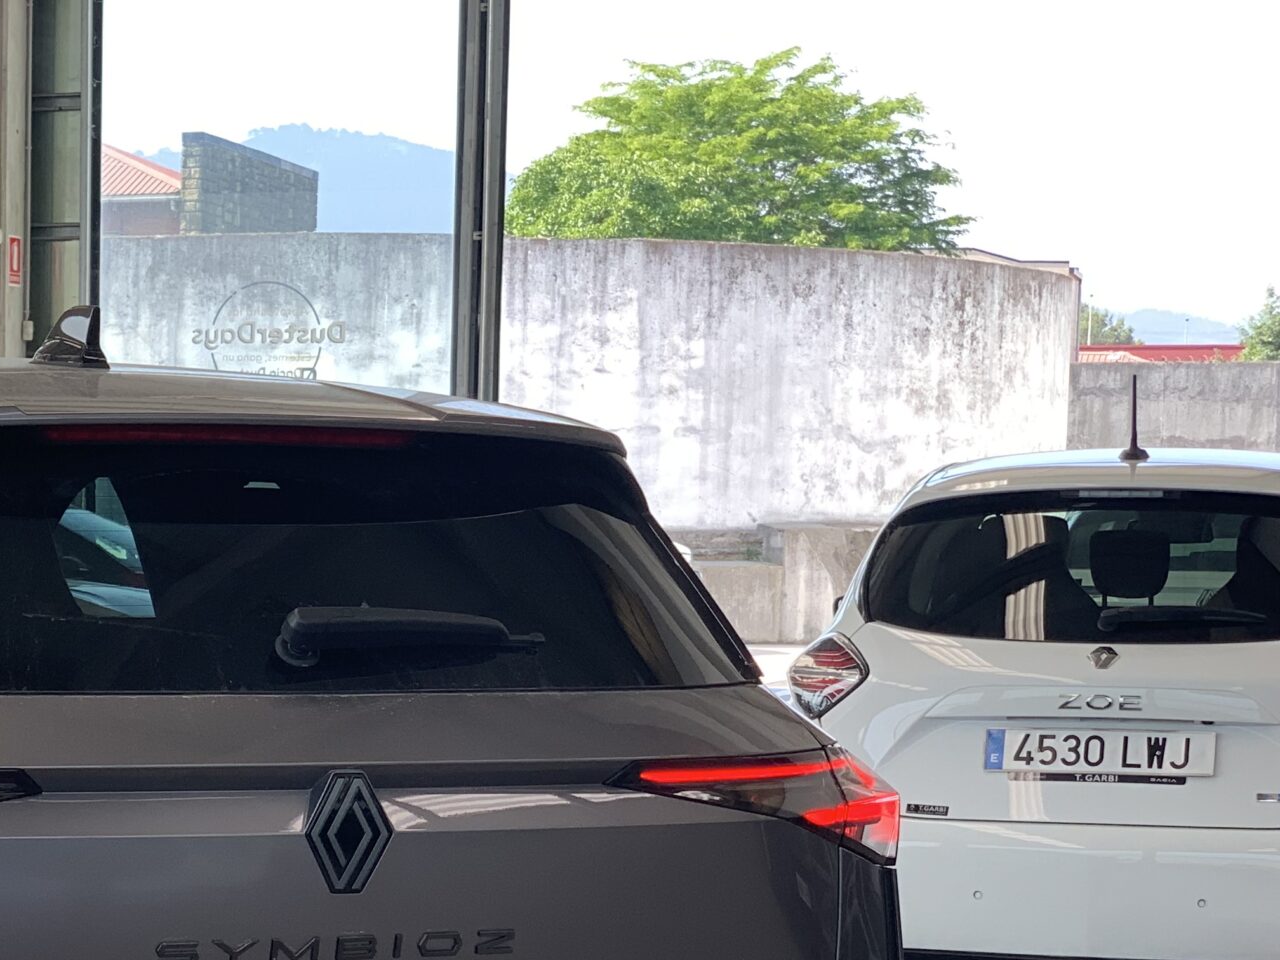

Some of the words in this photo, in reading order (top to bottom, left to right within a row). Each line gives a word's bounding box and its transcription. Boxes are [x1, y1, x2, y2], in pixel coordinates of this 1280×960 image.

[1058, 694, 1143, 711] ZOE
[1013, 733, 1105, 767] 4530
[1121, 736, 1191, 770] LWJ
[990, 754, 999, 763] E
[1085, 774, 1119, 782] GARBI
